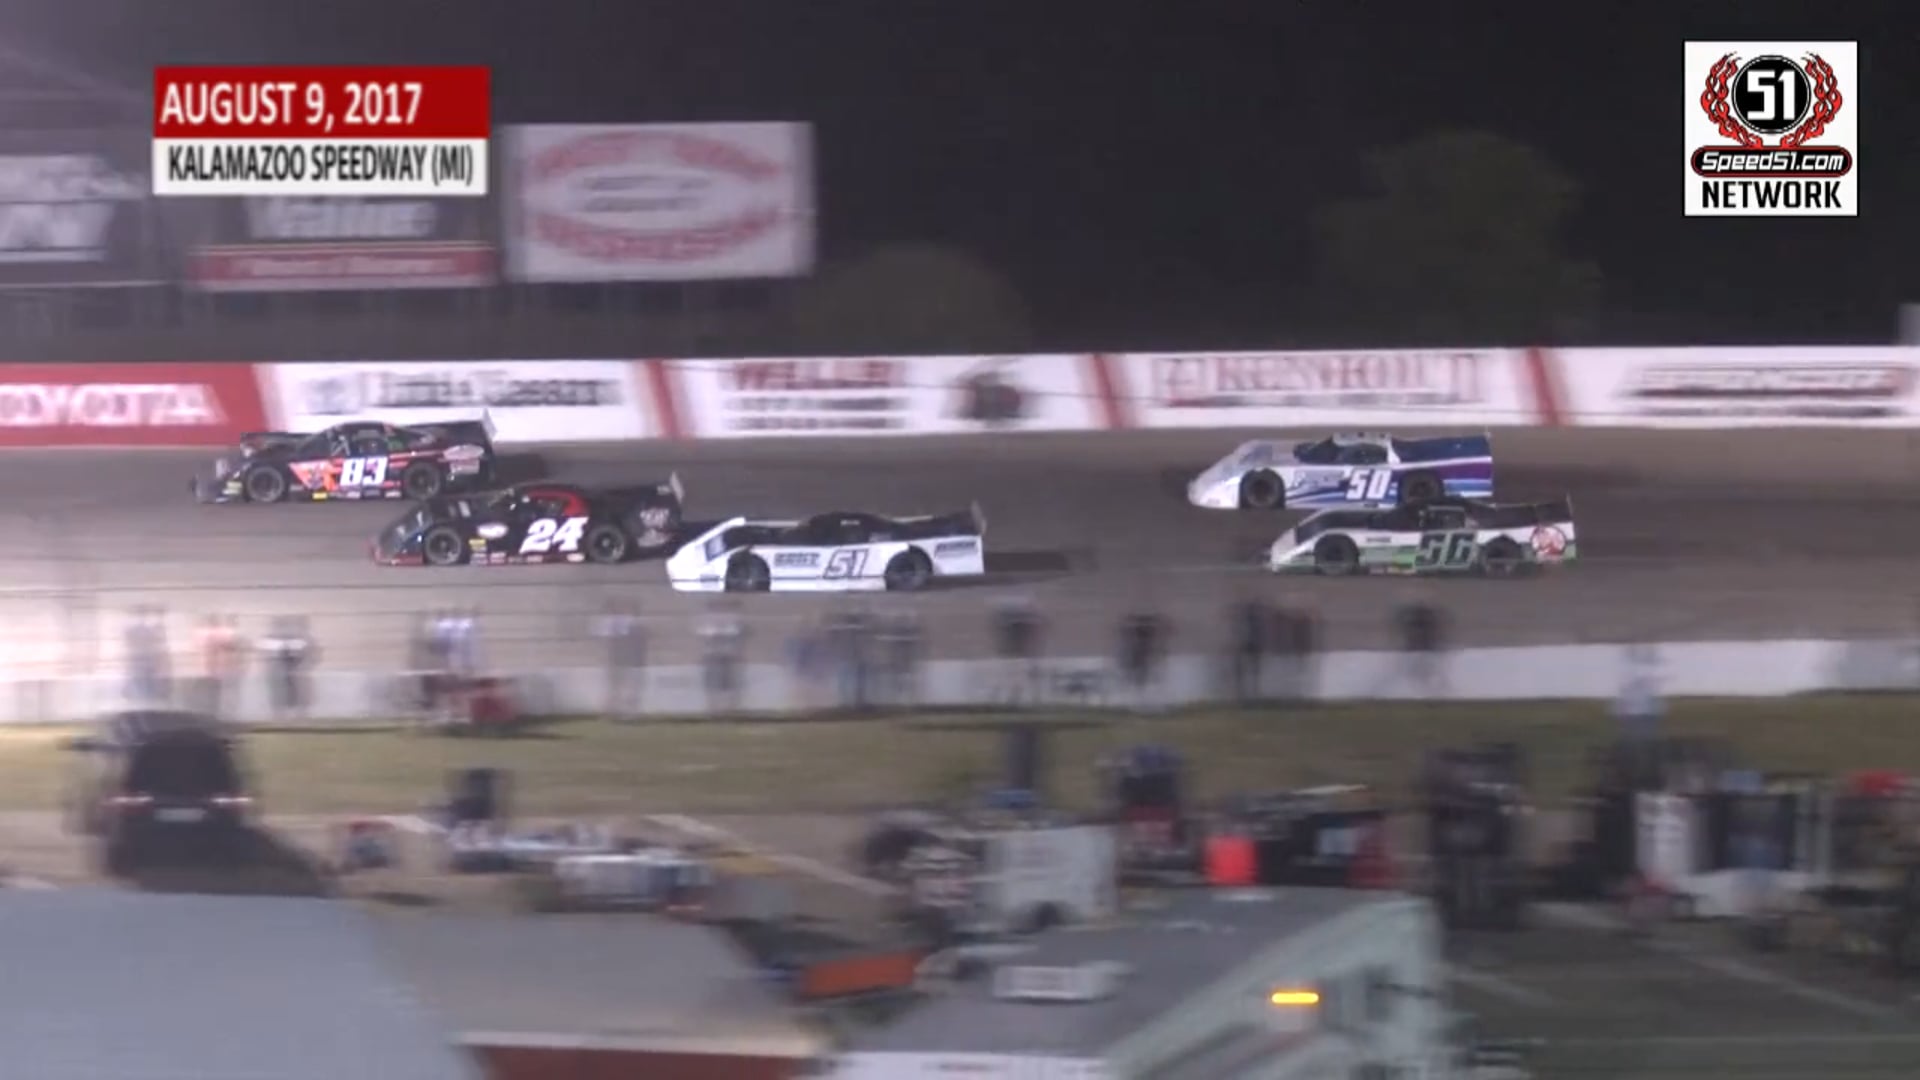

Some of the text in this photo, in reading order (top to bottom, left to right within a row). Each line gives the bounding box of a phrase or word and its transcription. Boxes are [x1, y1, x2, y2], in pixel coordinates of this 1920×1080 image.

[1346, 468, 1392, 500] 50
[519, 516, 588, 554] 24
[823, 548, 868, 580] 51
